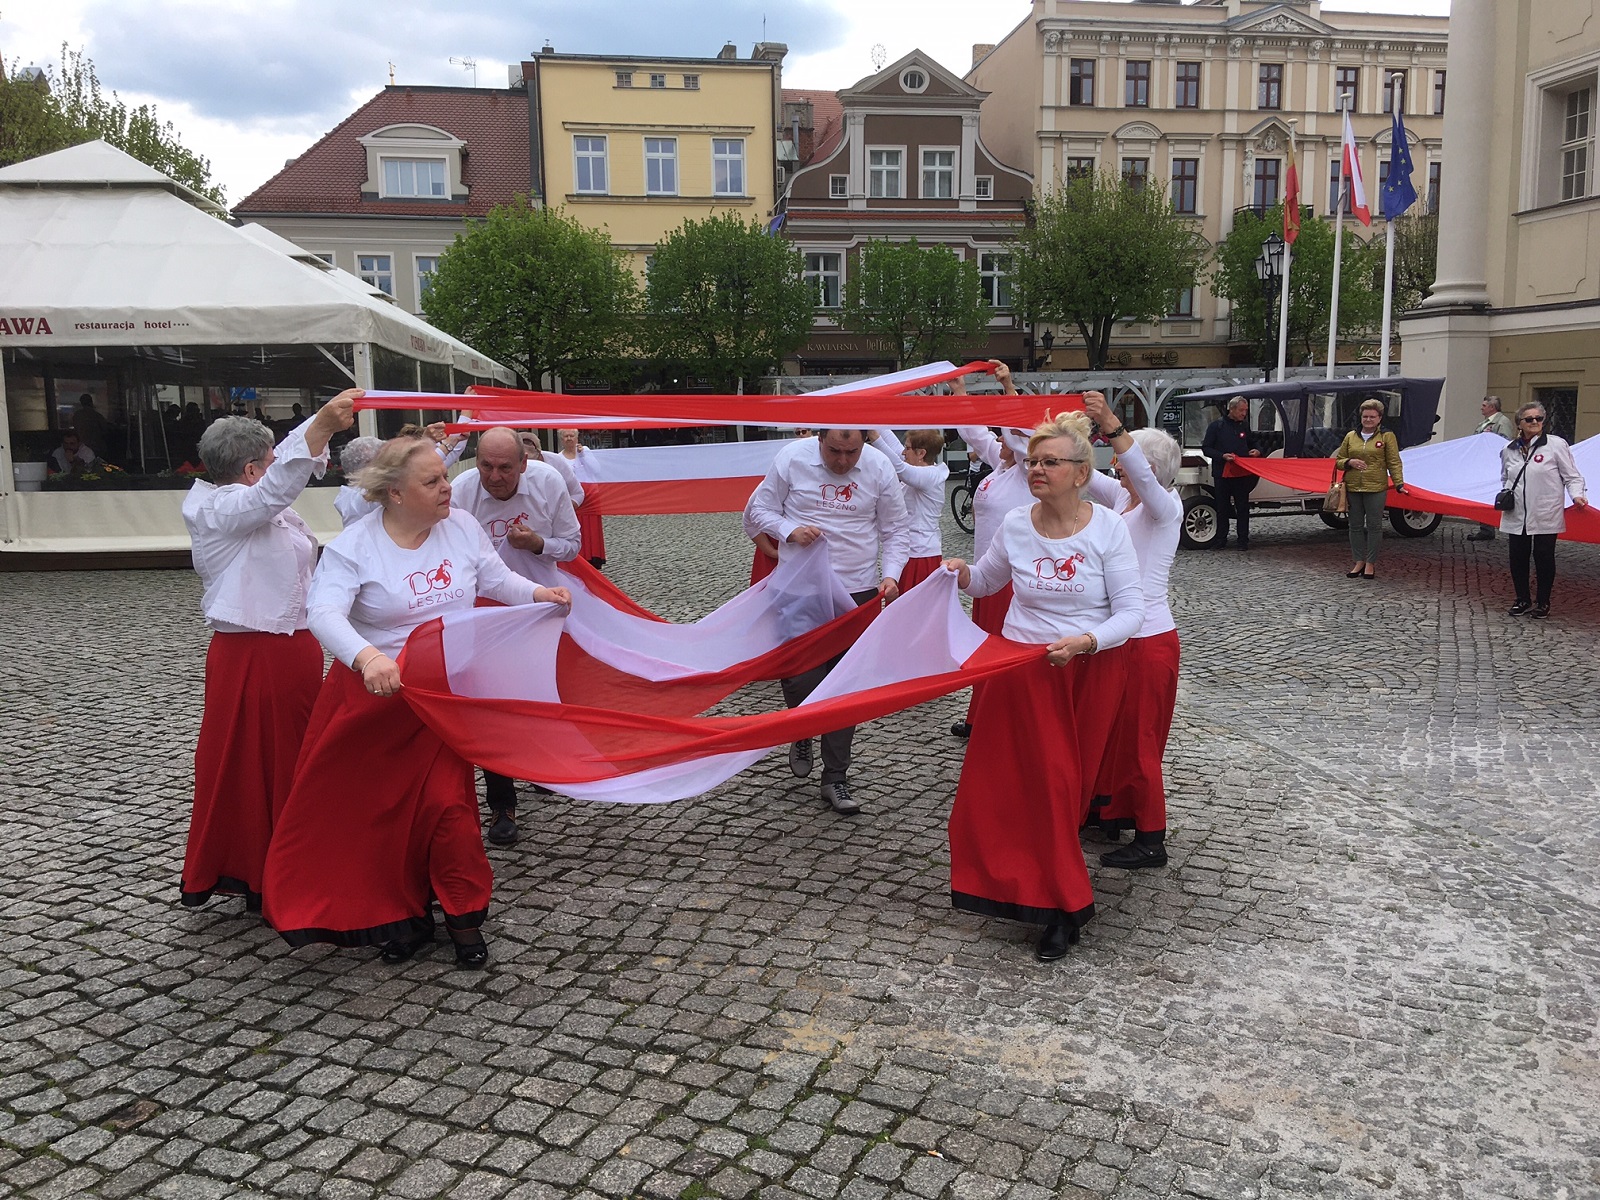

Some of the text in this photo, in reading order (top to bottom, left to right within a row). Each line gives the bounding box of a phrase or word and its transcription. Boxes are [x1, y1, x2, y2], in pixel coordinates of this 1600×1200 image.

[75, 321, 135, 331] restauracja
[807, 343, 859, 351] KAWIARNIA
[1163, 412, 1175, 421] 29
[816, 500, 857, 512] LESZNO
[1028, 579, 1085, 593] LESZNO
[407, 588, 465, 610] LESZNO
